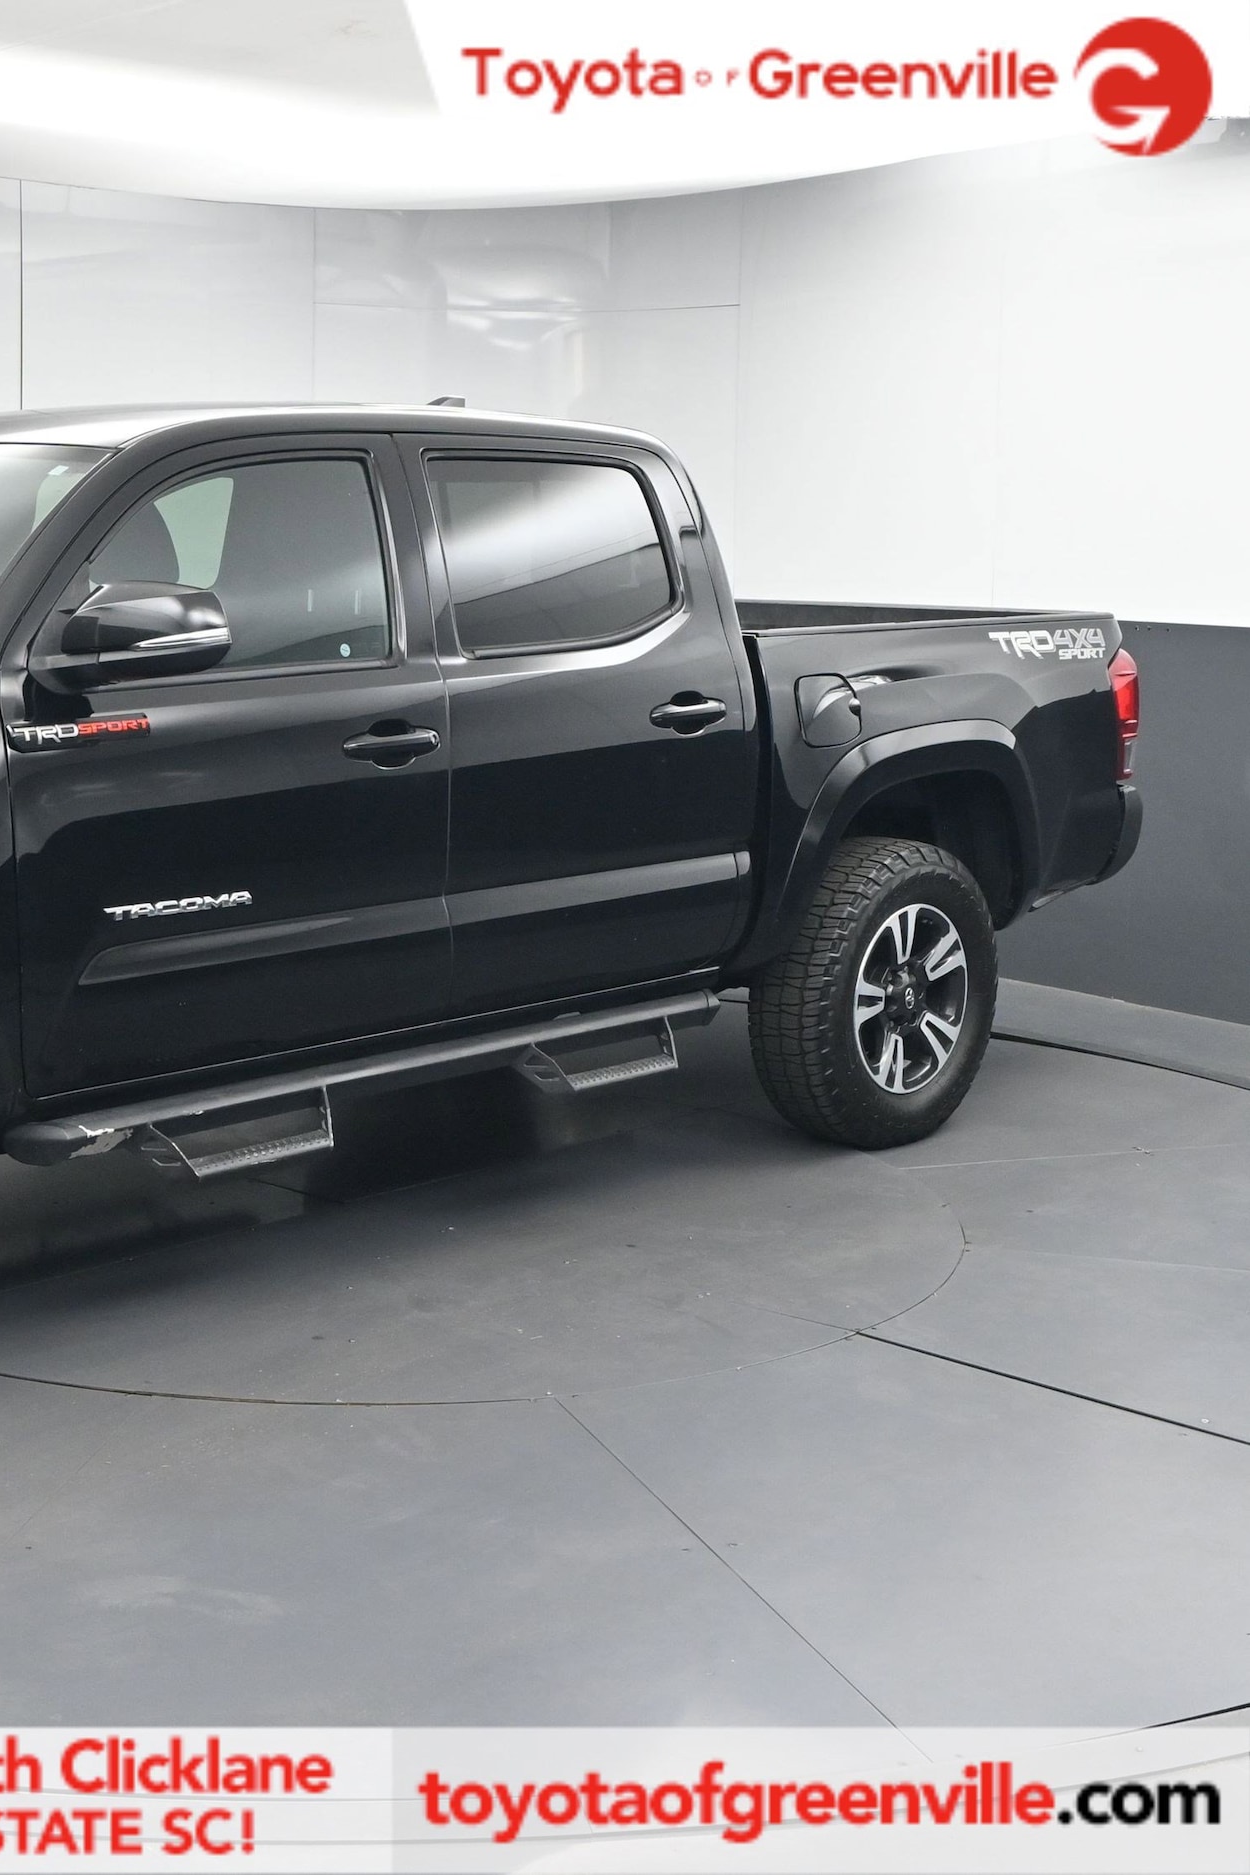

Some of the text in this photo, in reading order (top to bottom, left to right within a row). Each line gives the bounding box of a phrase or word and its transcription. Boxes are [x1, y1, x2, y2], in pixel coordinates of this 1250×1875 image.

[988, 629, 1056, 660] TRD
[1058, 648, 1106, 660] SPORT
[103, 890, 253, 921] TACOMA
